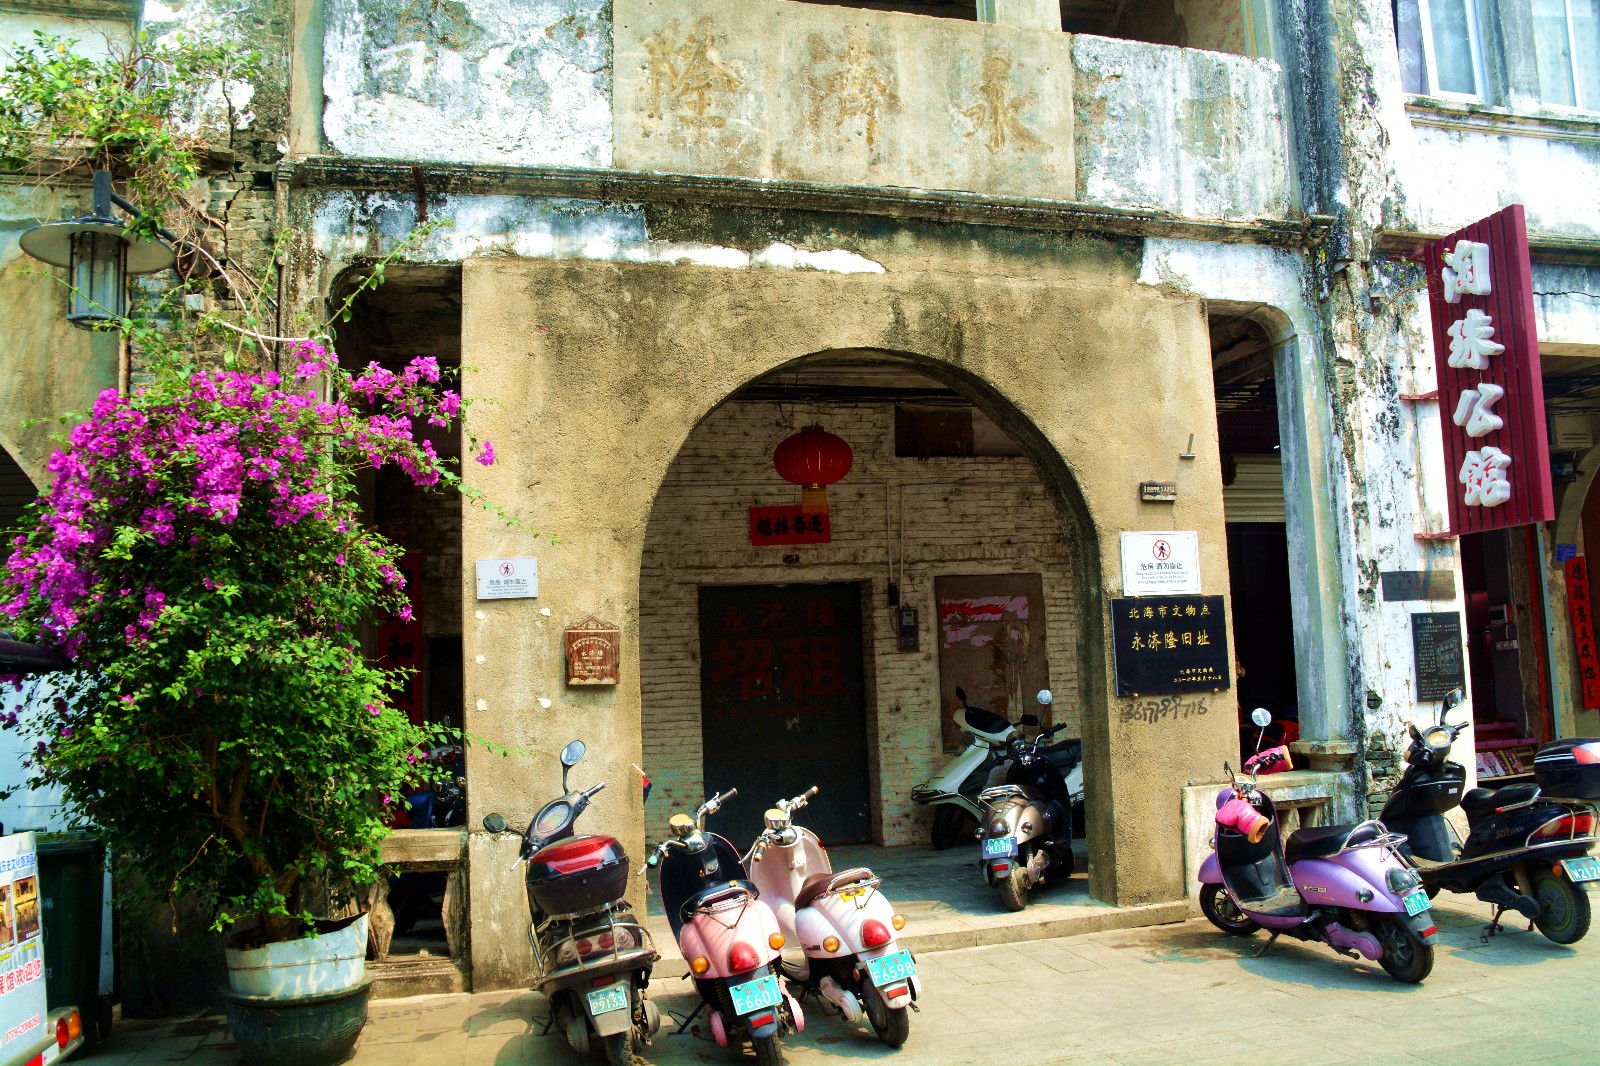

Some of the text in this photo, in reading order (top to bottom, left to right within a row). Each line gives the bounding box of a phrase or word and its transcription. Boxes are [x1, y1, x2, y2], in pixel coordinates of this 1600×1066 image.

[1128, 604, 1211, 619] 北海市文物点
[1131, 629, 1211, 652] 永济隆旧址
[708, 634, 848, 702] 招租
[0, 853, 35, 873] 历史文化旅游区
[872, 961, 914, 985] F6598
[592, 995, 625, 1013] P9133
[735, 988, 779, 1013] F6601
